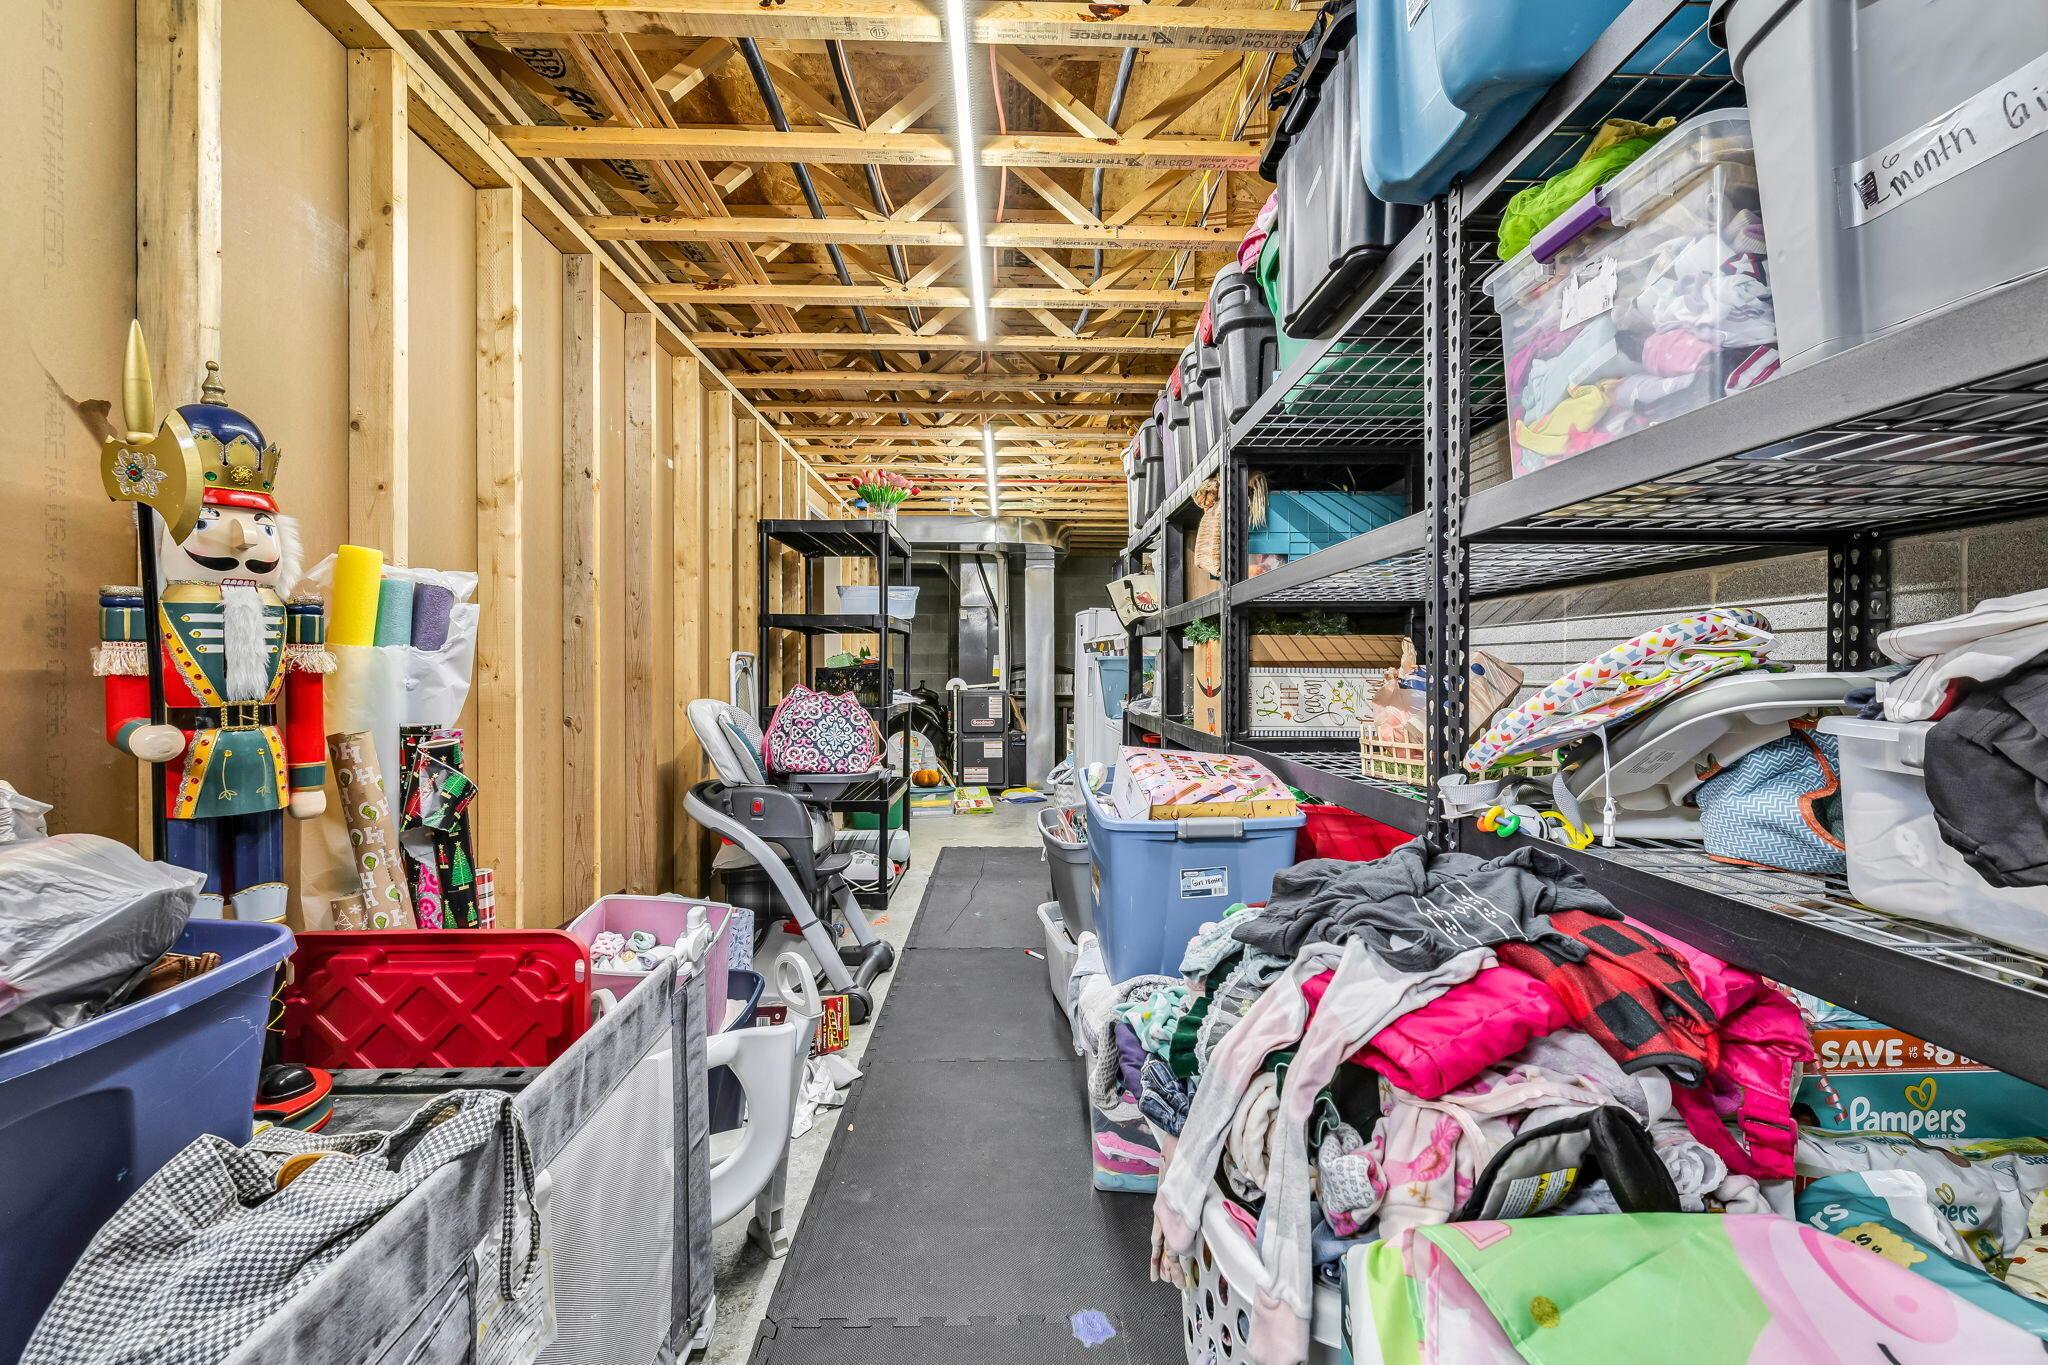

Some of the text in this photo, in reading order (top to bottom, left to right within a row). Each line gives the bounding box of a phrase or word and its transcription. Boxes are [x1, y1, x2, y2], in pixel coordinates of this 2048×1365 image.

[1070, 32, 1150, 41] TRIFORCE
[1881, 87, 2048, 197] 6 month Gi
[1279, 682, 1299, 709] THE
[1330, 687, 1342, 704] to
[1821, 1039, 1904, 1069] SAVE
[1850, 1096, 1967, 1135] Pampers
